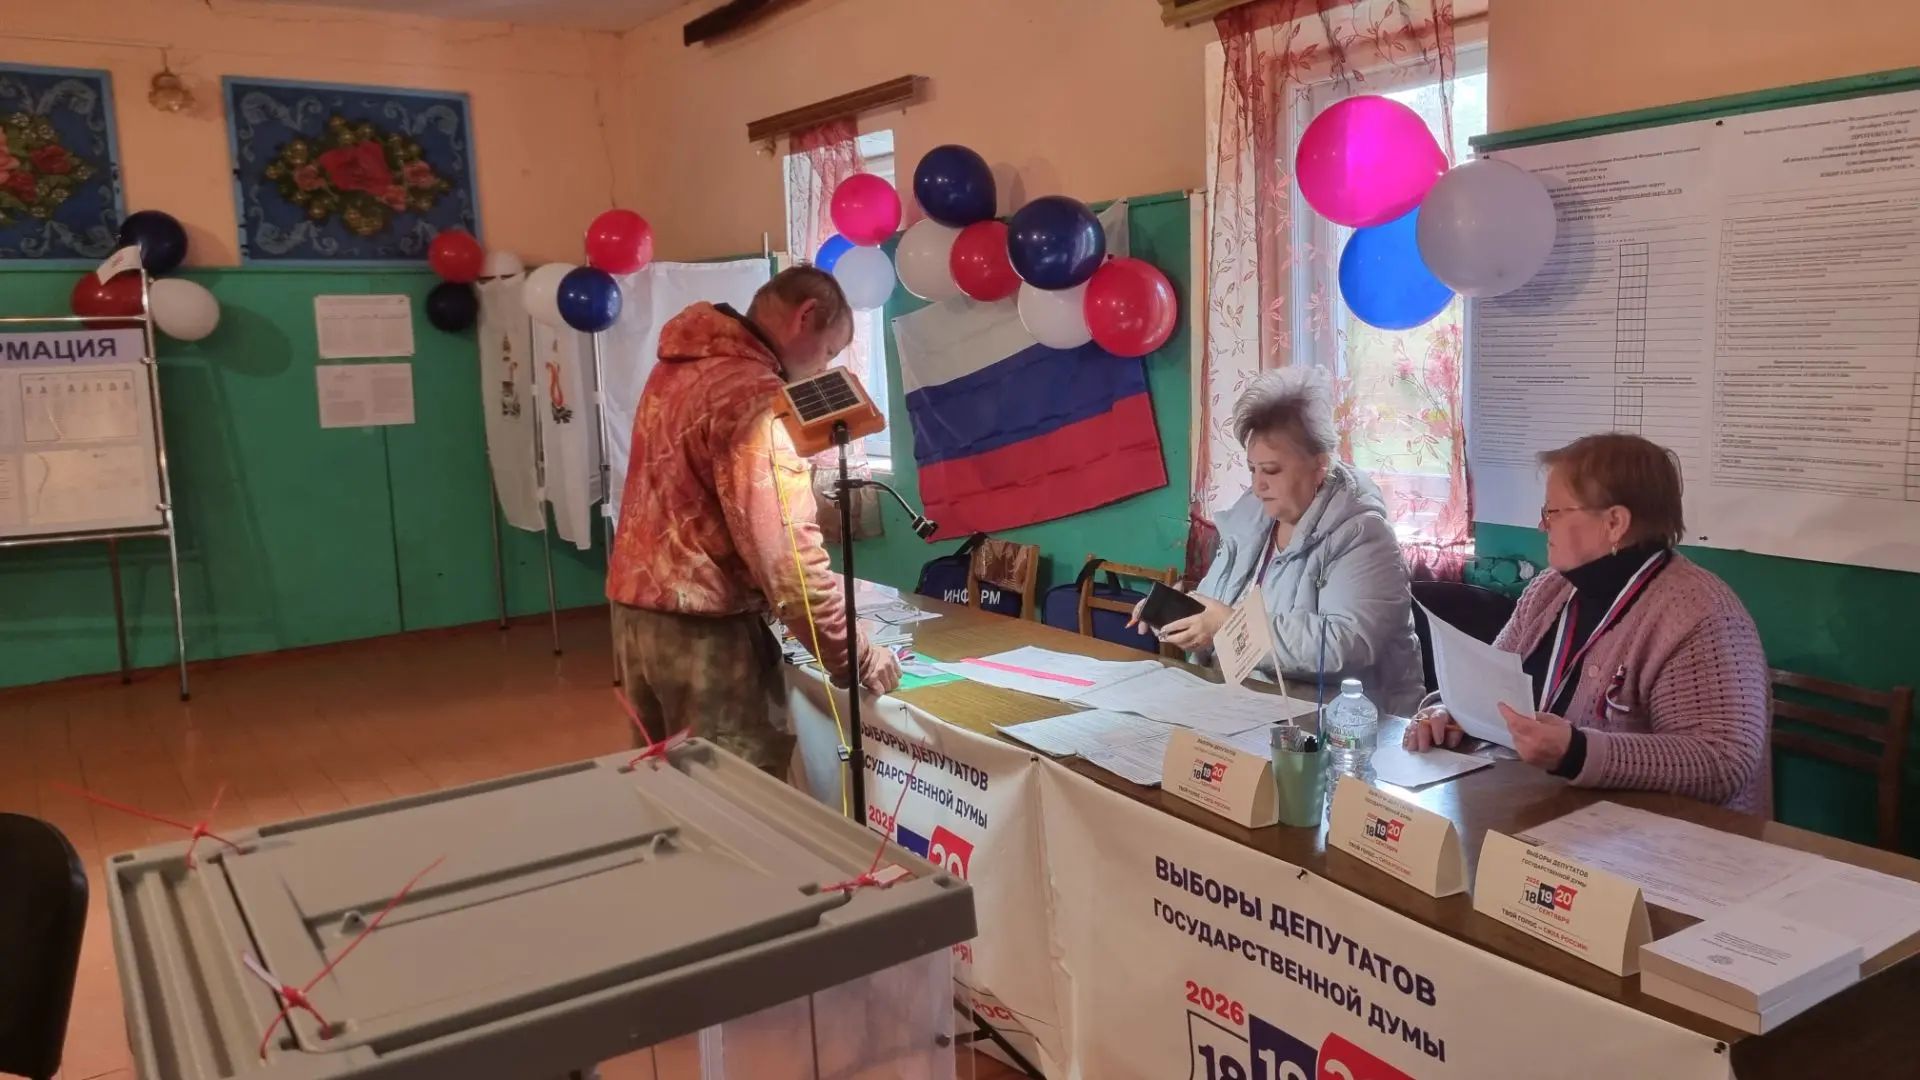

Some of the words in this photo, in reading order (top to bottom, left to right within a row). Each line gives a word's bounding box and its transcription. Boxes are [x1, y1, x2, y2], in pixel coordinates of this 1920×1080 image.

[0, 338, 117, 362] МАЦИЯ
[943, 587, 1001, 605] ИНФРМ
[861, 721, 909, 754] ЫБОРЫ
[911, 742, 989, 792] ДЕПУТАТОВ
[1193, 768, 1201, 780] 18
[1213, 766, 1223, 778] 20
[864, 754, 955, 811] СУДАРСТВЕННОЙ
[955, 797, 988, 830] ДУМЫ
[868, 805, 895, 833] 2026
[1366, 824, 1375, 837] 18
[1377, 823, 1387, 836] 19
[1389, 823, 1400, 837] 20
[1522, 858, 1571, 881] ГОСУДАРСТВЕННОЙ
[1526, 849, 1552, 864] ВЫБОРЫ
[1552, 860, 1589, 877] ДЕПУТАТОВ
[1525, 890, 1537, 904] 18
[1540, 888, 1553, 904] 19
[1555, 889, 1571, 905] 20
[1502, 908, 1517, 920] ТВОЙ
[1539, 907, 1570, 924] СЕНТЯБРЯ
[1155, 856, 1263, 921] ВЫБОРЫ
[1269, 903, 1437, 1007] ДЕПУТАТОВ
[1153, 898, 1362, 1017] ГОСУДАРСТВЕННОЙ
[1367, 1002, 1446, 1062] ДУМЫ
[1185, 980, 1245, 1026] 2026
